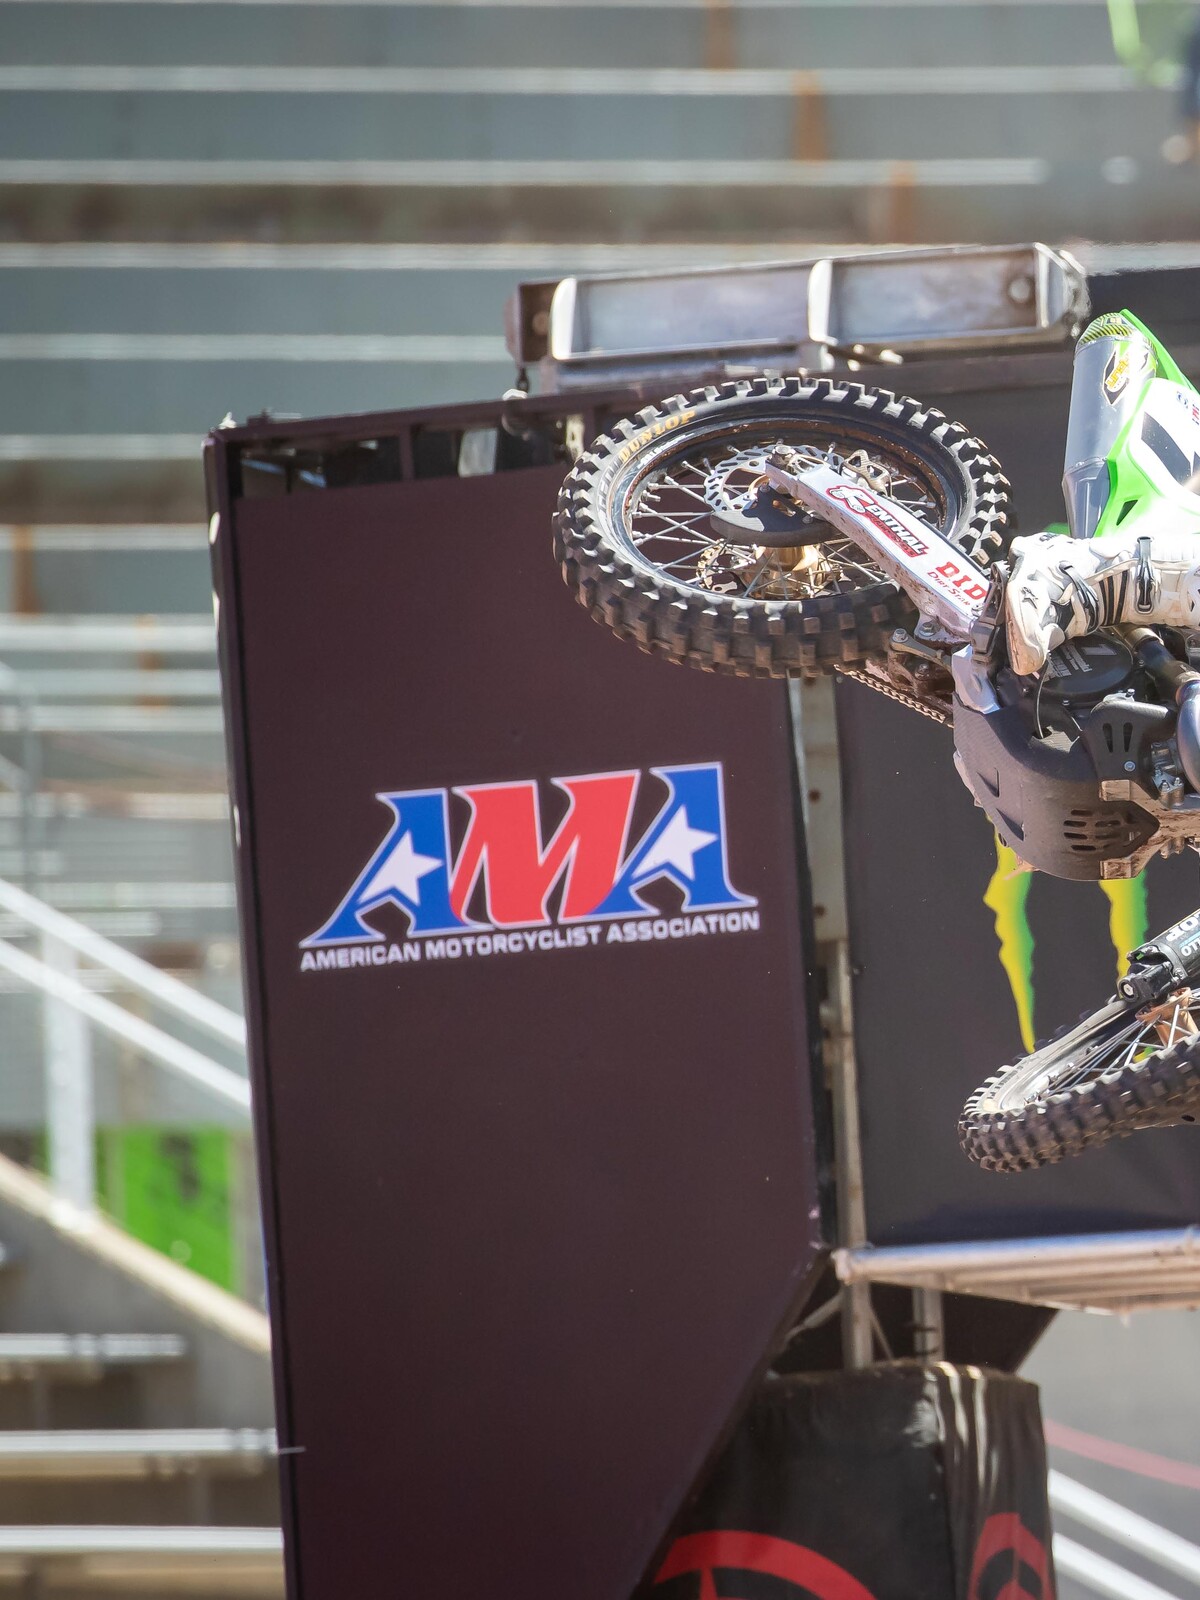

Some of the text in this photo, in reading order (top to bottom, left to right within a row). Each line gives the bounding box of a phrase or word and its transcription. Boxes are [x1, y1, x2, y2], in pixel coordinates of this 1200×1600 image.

[618, 411, 696, 463] DUNLOP
[829, 487, 926, 556] RENTHAL
[935, 561, 987, 600] DID
[299, 761, 758, 946] AMA
[300, 911, 760, 972] AMERICAN MOTORCYCLIST ASSOCIATION
